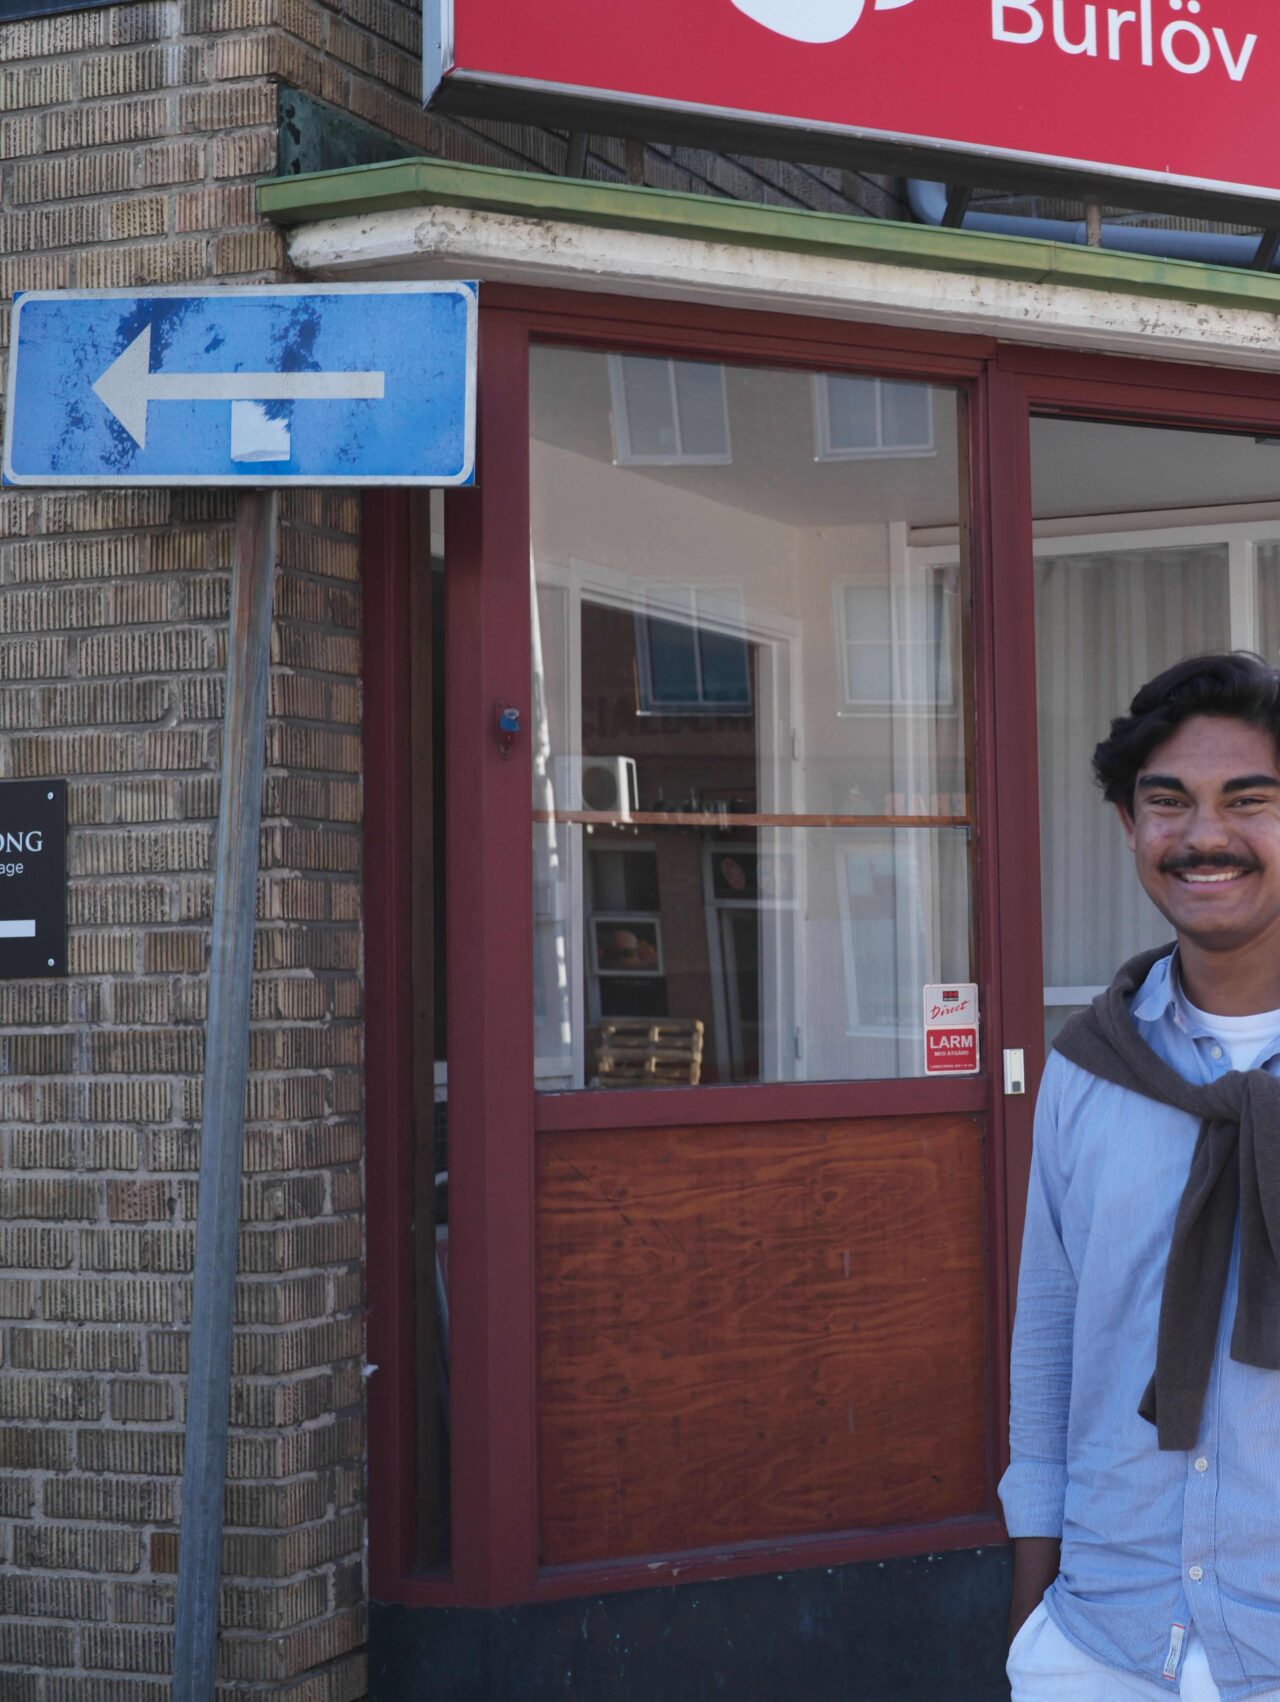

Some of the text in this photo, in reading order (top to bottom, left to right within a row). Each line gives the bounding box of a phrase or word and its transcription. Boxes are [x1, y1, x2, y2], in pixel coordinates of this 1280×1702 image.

[992, 0, 1258, 82] Burlöv
[0, 831, 43, 852] NG
[931, 1000, 970, 1019] Direct
[930, 1035, 973, 1049] LARM
